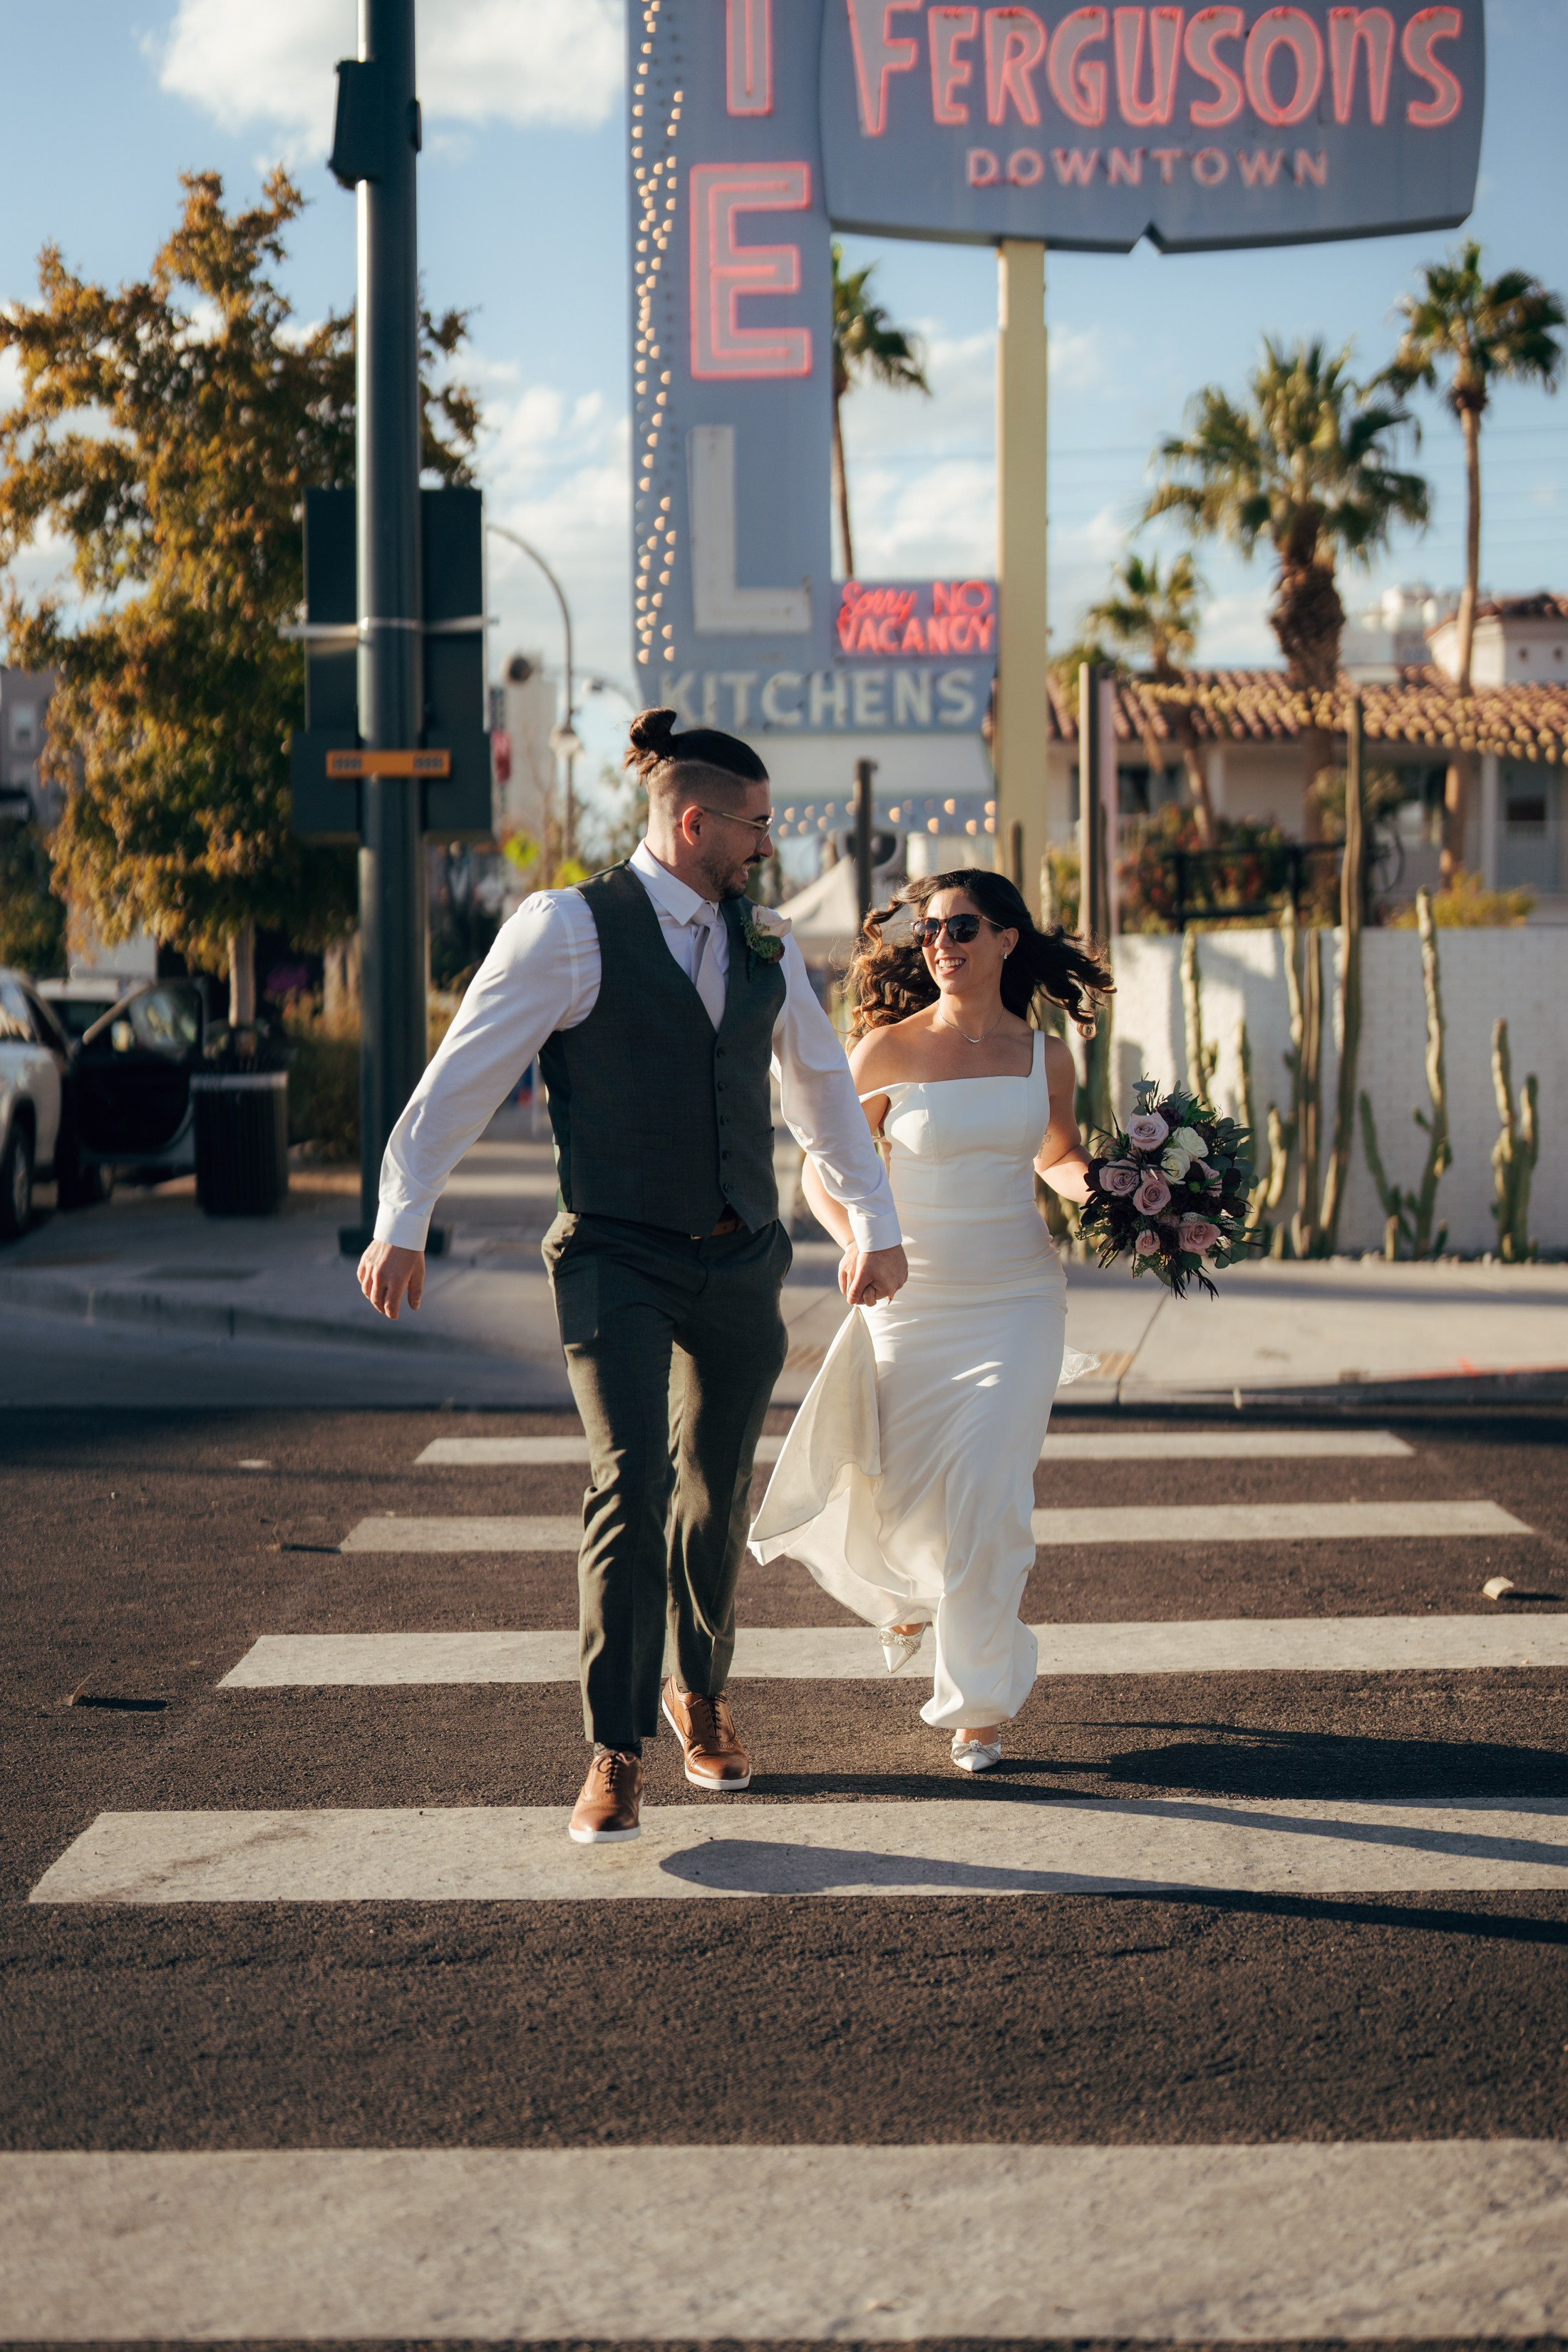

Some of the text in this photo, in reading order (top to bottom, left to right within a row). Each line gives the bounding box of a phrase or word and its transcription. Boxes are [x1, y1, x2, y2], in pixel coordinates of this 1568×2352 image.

[964, 148, 1330, 188] DOWNTOWN
[838, 579, 992, 624] Sorry NO
[836, 613, 995, 655] VACANCY
[659, 669, 976, 728] KITCHENS
